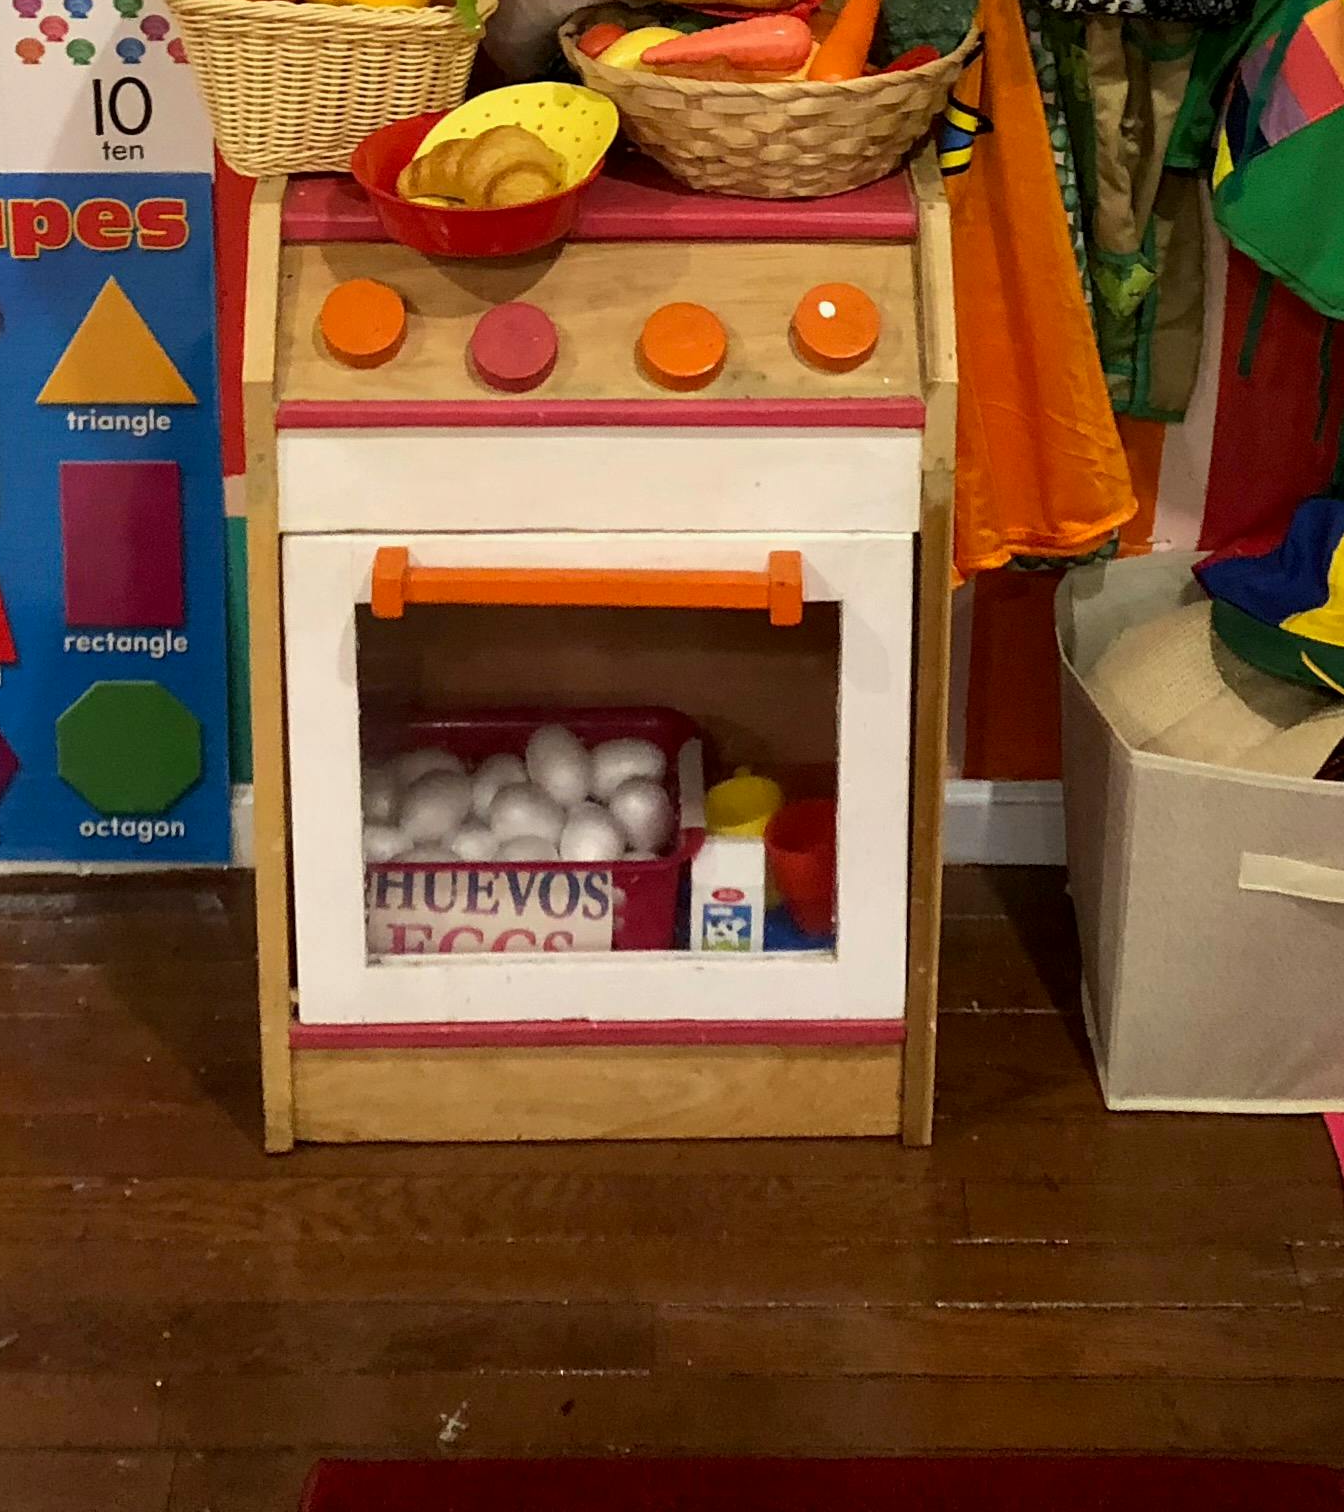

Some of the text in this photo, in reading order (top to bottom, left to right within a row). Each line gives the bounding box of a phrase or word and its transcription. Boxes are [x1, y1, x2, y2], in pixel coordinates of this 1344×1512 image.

[94, 77, 152, 136] 10
[102, 140, 145, 162] ten
[67, 408, 171, 435] triangle
[63, 630, 188, 659] rectangle
[79, 814, 185, 841] octagon
[375, 871, 611, 921] HUEVOS
